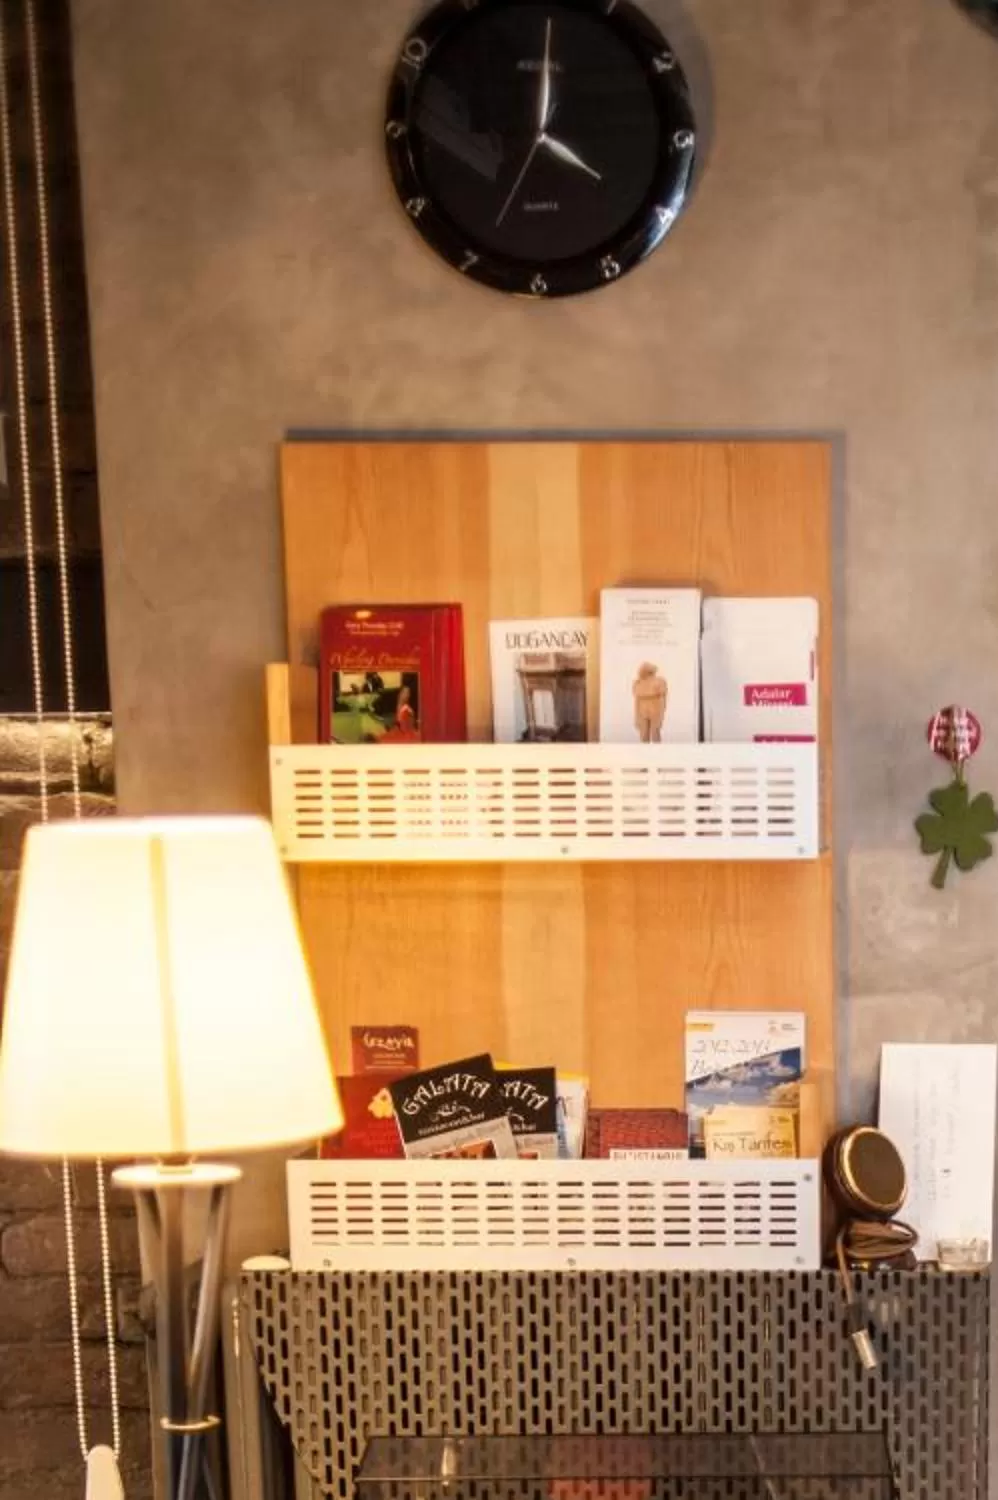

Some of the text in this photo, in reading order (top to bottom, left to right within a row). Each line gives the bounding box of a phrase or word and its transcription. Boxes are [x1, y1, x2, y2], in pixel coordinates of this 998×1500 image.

[751, 687, 792, 699] Adalar
[402, 1073, 491, 1115] GALATA
[500, 1080, 549, 1110] ATA
